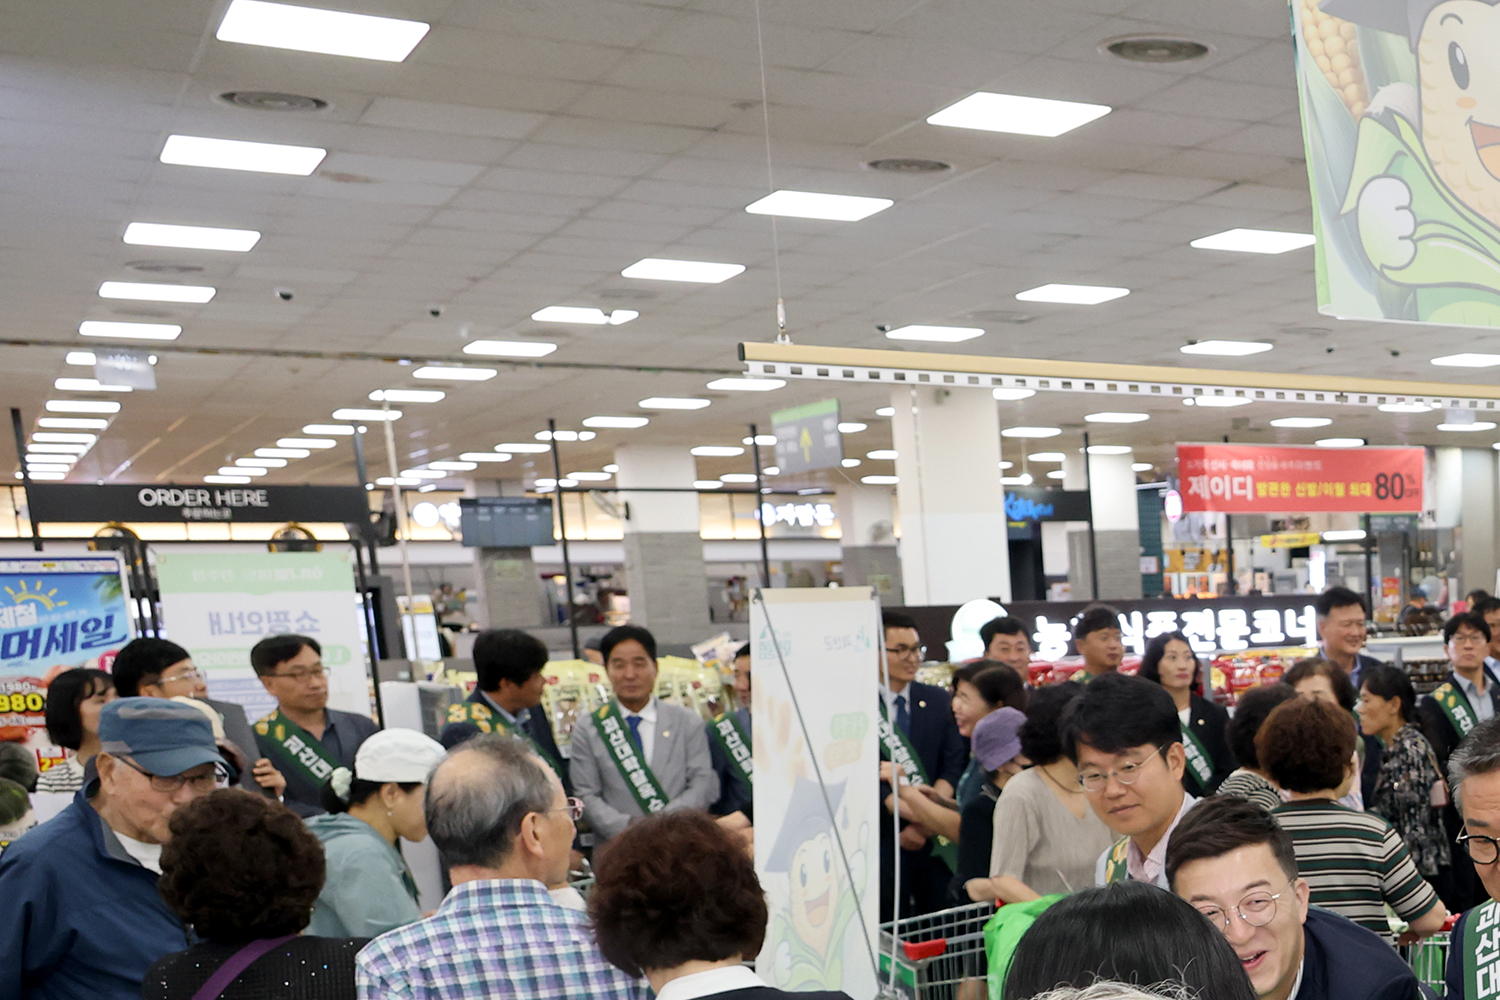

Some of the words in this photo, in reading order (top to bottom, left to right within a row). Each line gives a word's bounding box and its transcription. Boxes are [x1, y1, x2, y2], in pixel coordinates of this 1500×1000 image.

[138, 488, 212, 507] ORDER
[214, 489, 270, 507] HERE
[1187, 475, 1253, 501] 제이디
[1033, 603, 1318, 660] 농식품전문코너
